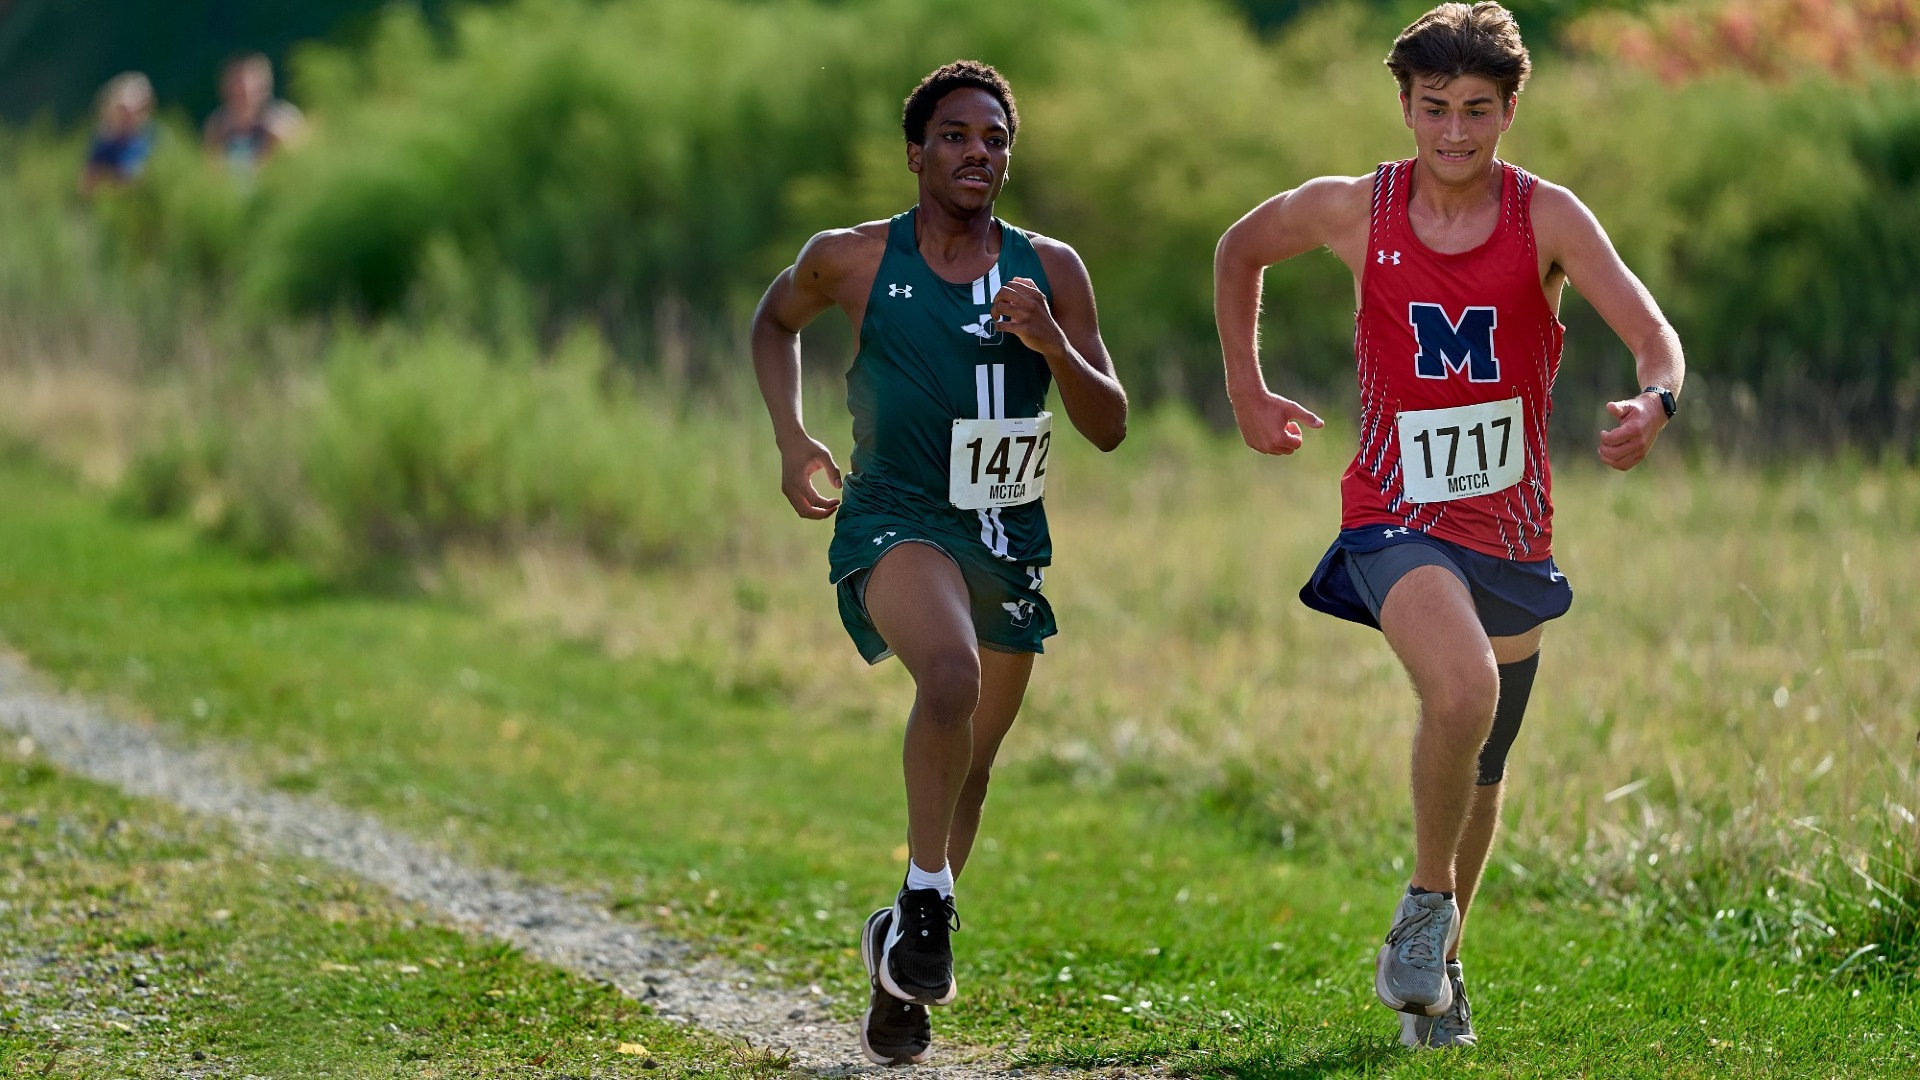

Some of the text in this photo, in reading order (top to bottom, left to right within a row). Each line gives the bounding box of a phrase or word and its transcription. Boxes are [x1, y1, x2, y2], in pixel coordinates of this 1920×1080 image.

[1408, 301, 1501, 383] M
[966, 431, 1051, 484] 1472
[1413, 416, 1512, 478] 1717
[989, 483, 1026, 499] MCTCA
[1447, 472, 1490, 493] MCTCA
